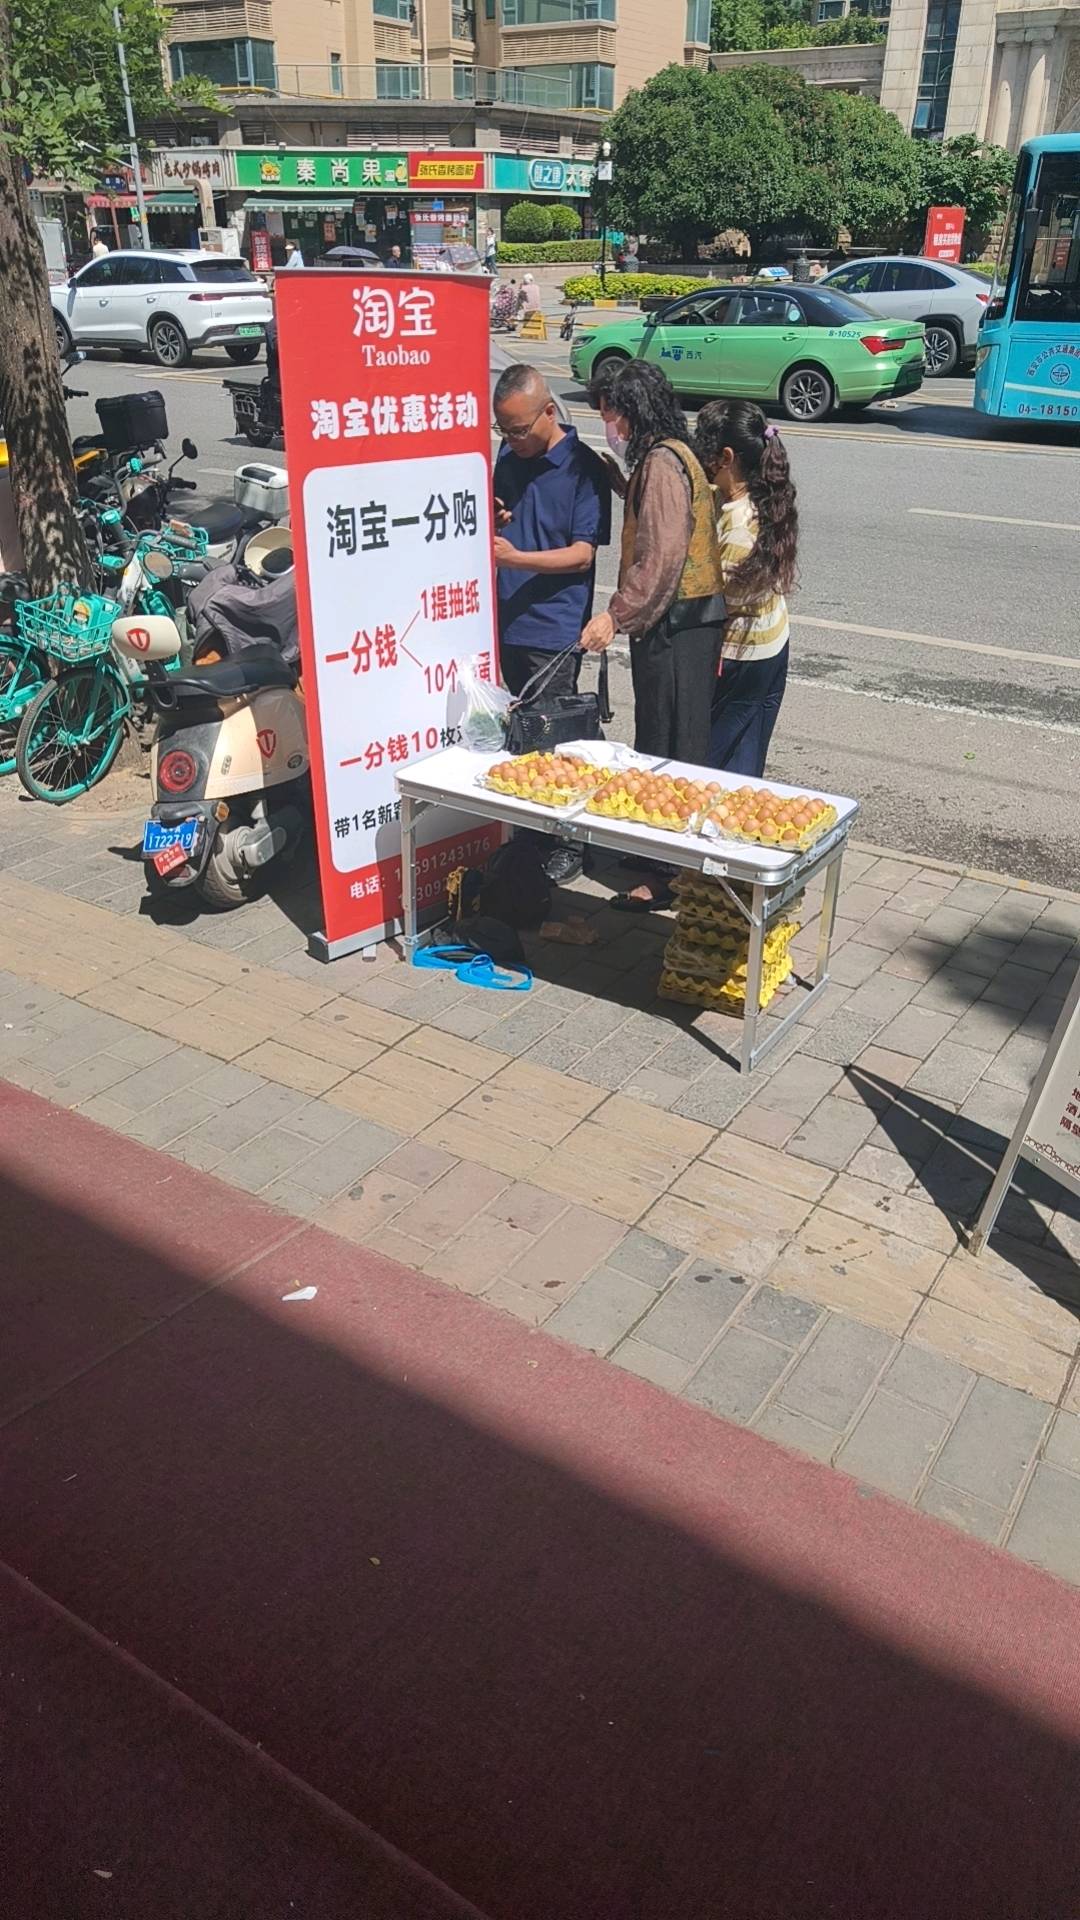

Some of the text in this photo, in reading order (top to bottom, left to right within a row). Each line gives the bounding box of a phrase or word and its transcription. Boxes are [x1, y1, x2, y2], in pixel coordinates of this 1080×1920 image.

[296, 157, 382, 186] 秦尚果
[419, 163, 475, 177] 张氏香烤面筋
[352, 286, 437, 338] 淘宝
[362, 344, 431, 367] Taobao
[310, 391, 479, 440] 淘宝优惠活动
[1018, 403, 1078, 416] 04-18150
[326, 489, 478, 558] 淘宝一分购
[420, 579, 480, 622] 1提抽纸
[325, 623, 399, 674] 一分钱
[339, 724, 464, 771] 一分钱10枚
[394, 836, 491, 882] 1591243176
